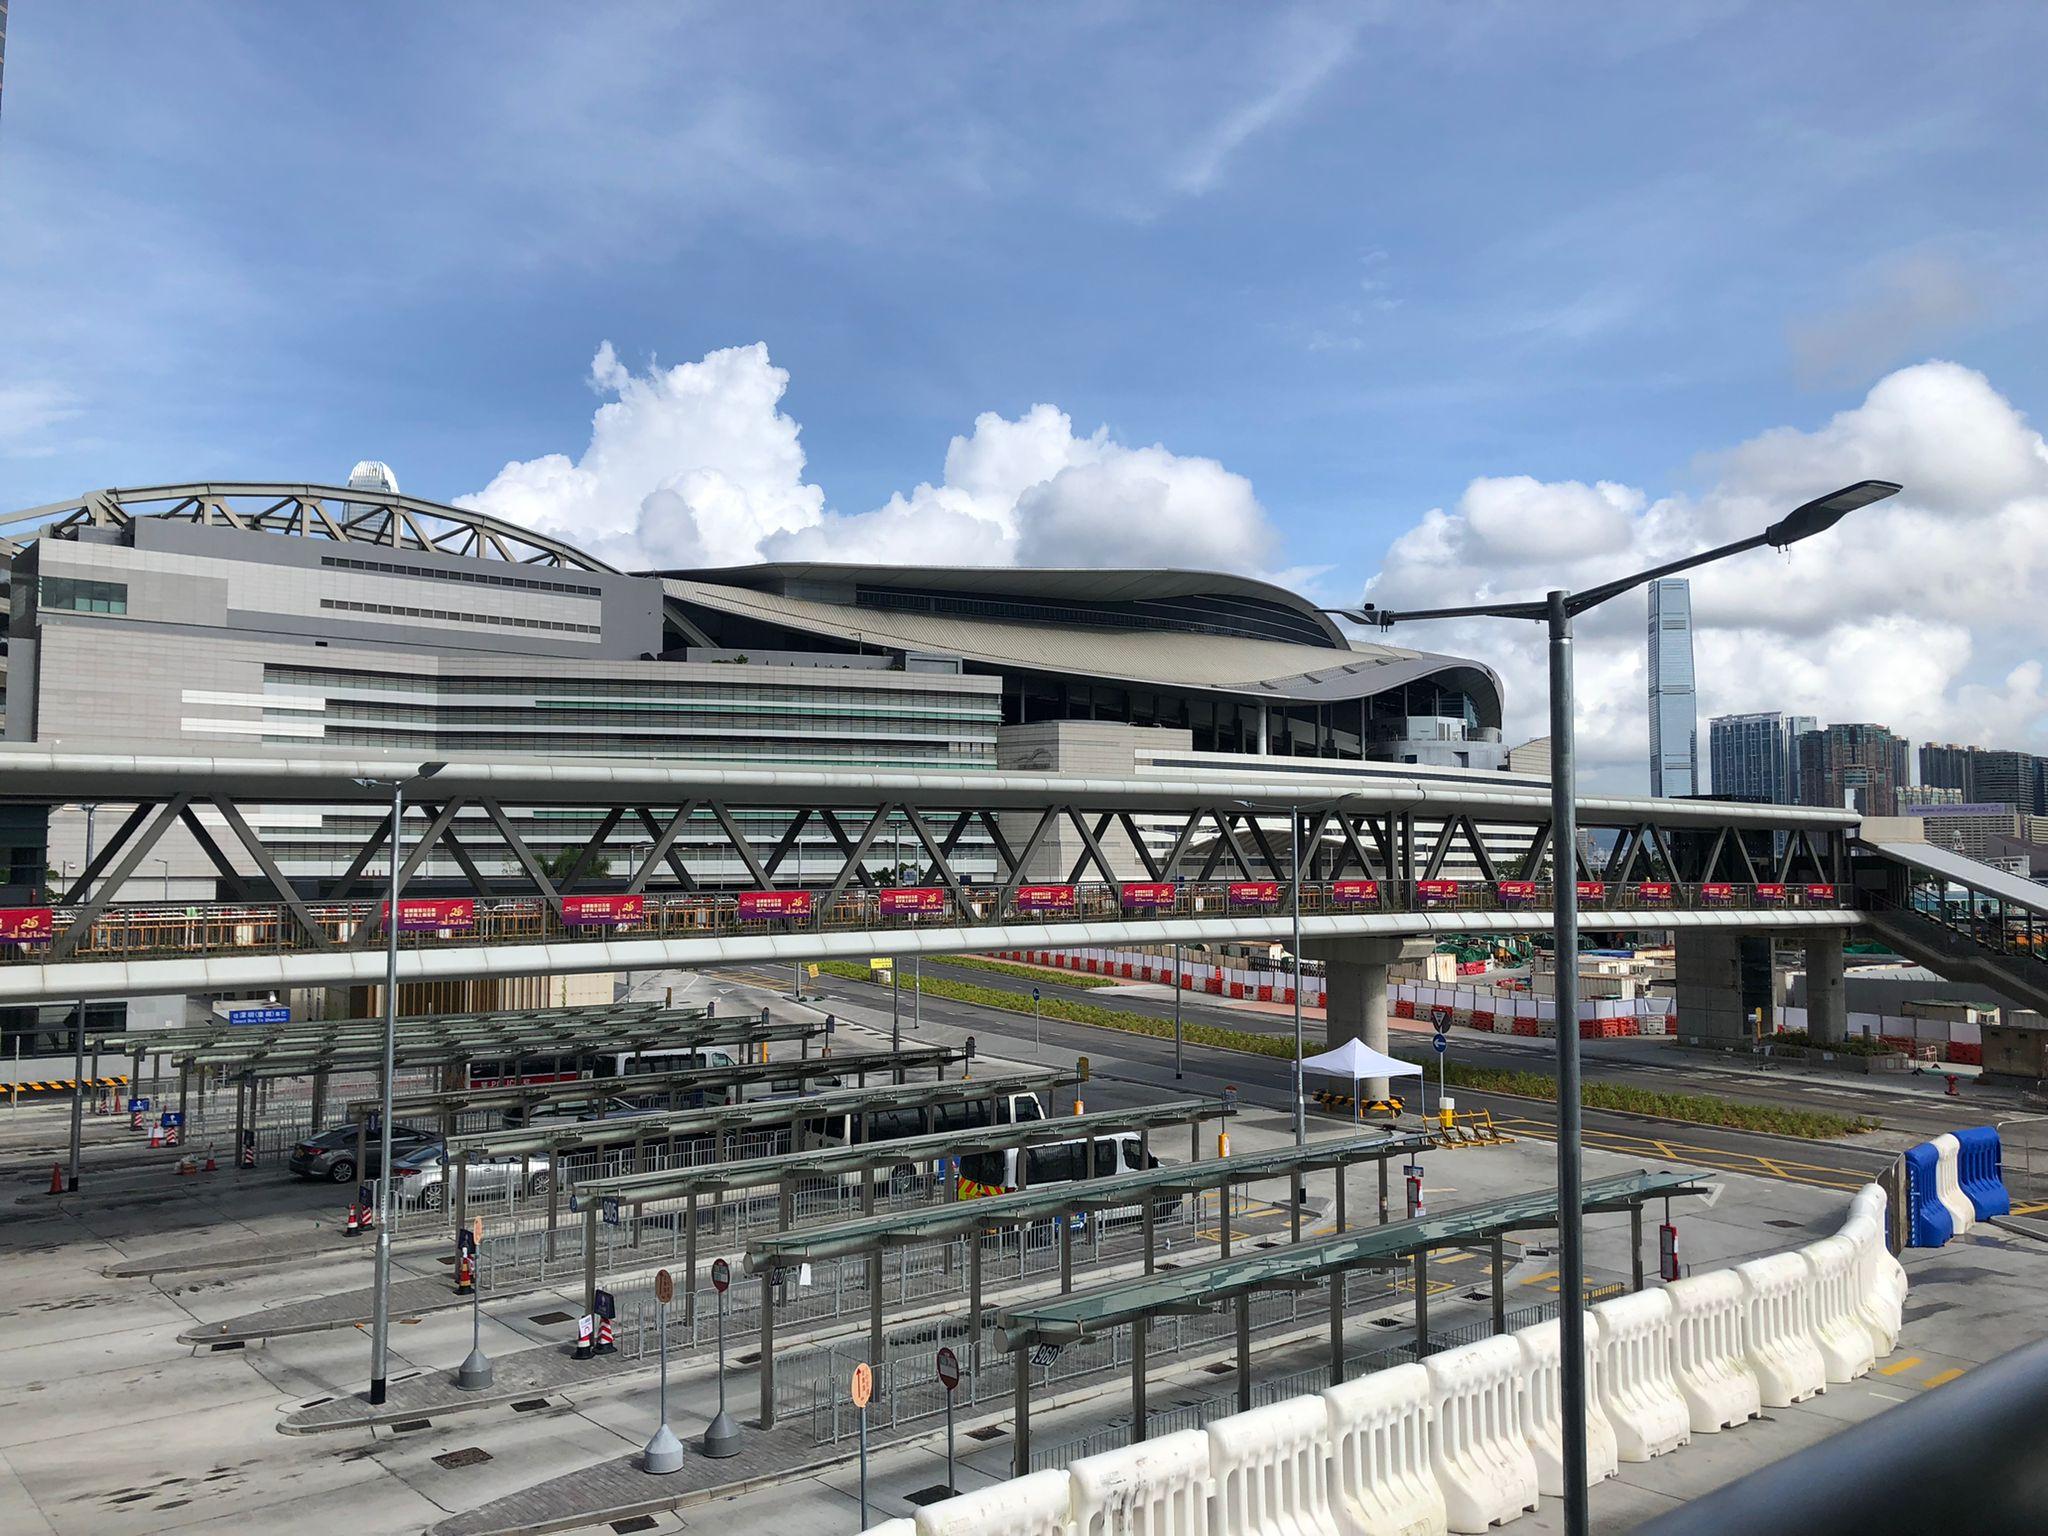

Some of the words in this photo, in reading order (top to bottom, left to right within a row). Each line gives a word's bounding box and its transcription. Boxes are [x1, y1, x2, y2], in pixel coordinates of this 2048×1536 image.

[449, 905, 464, 917] 25
[622, 900, 635, 912] 25
[20, 915, 39, 929] 25
[1035, 1345, 1058, 1364] 960
